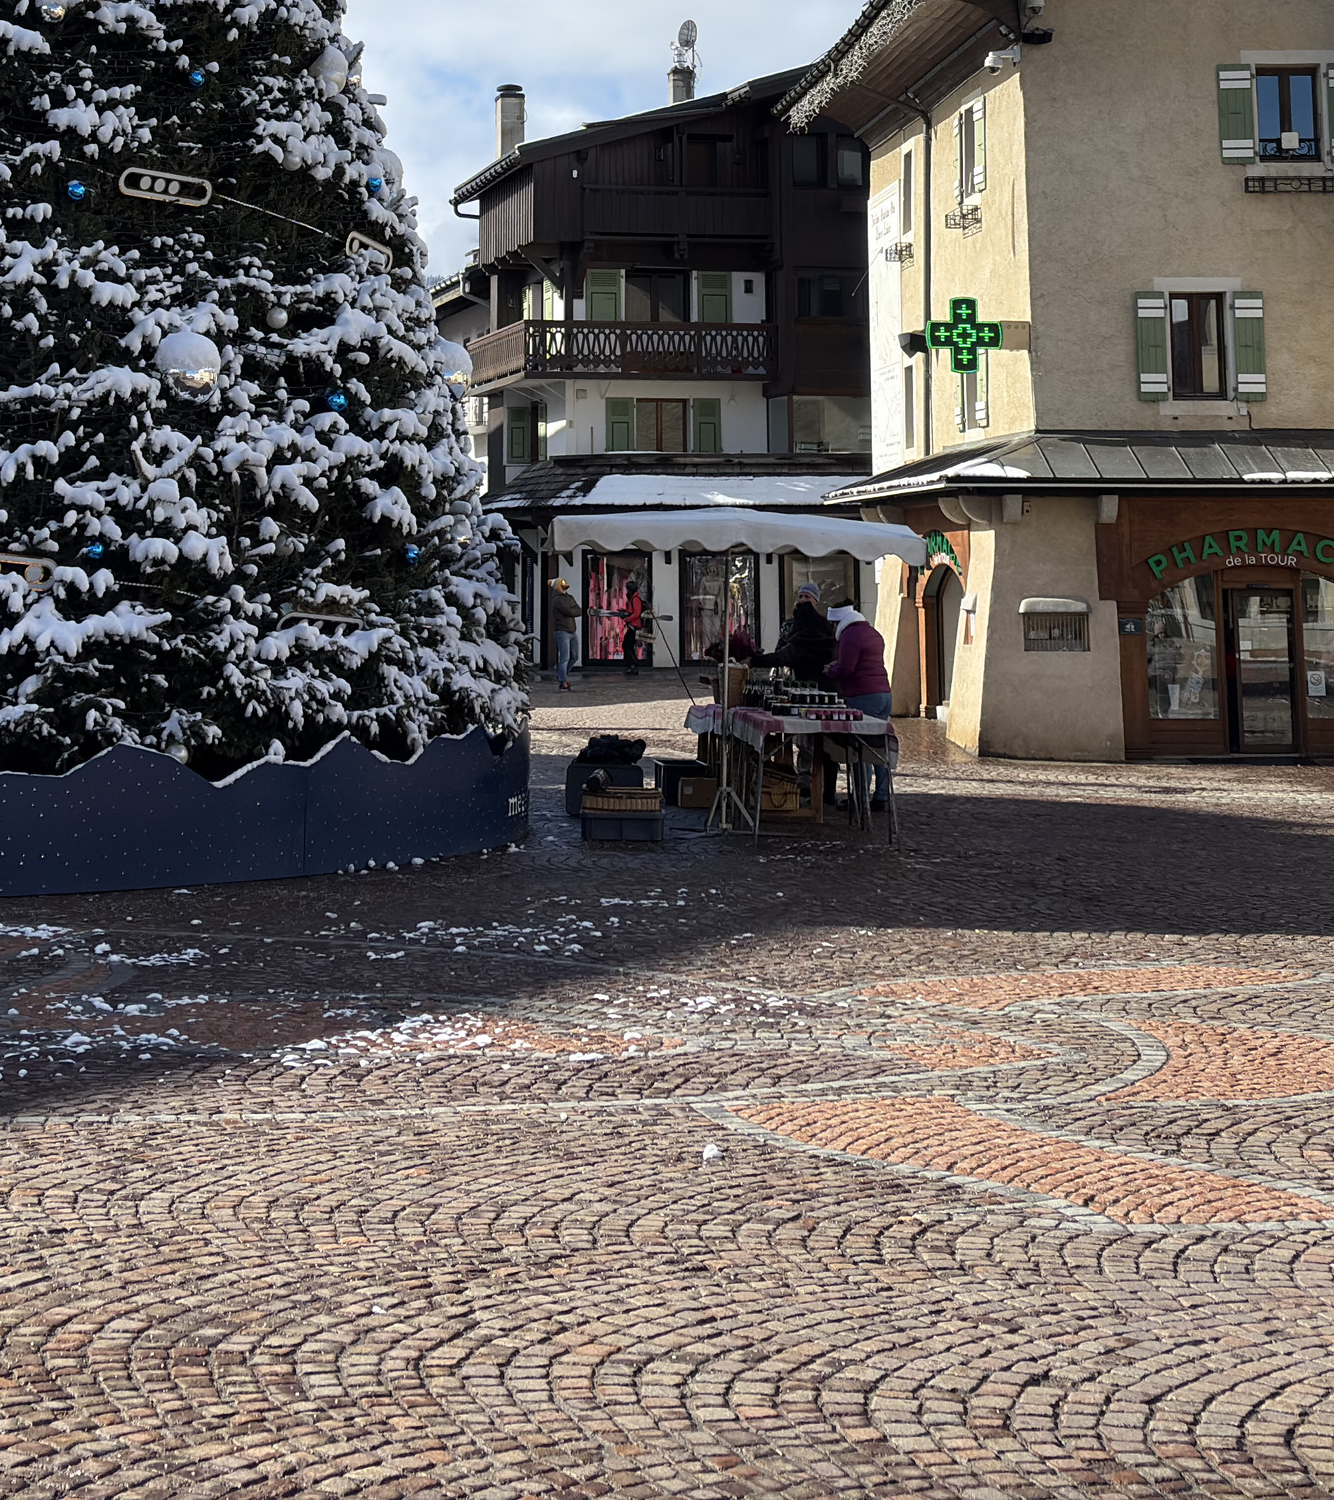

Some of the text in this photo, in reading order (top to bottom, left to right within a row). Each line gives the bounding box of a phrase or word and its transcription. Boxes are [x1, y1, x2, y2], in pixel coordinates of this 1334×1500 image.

[1226, 553, 1297, 567] de la TOUR
